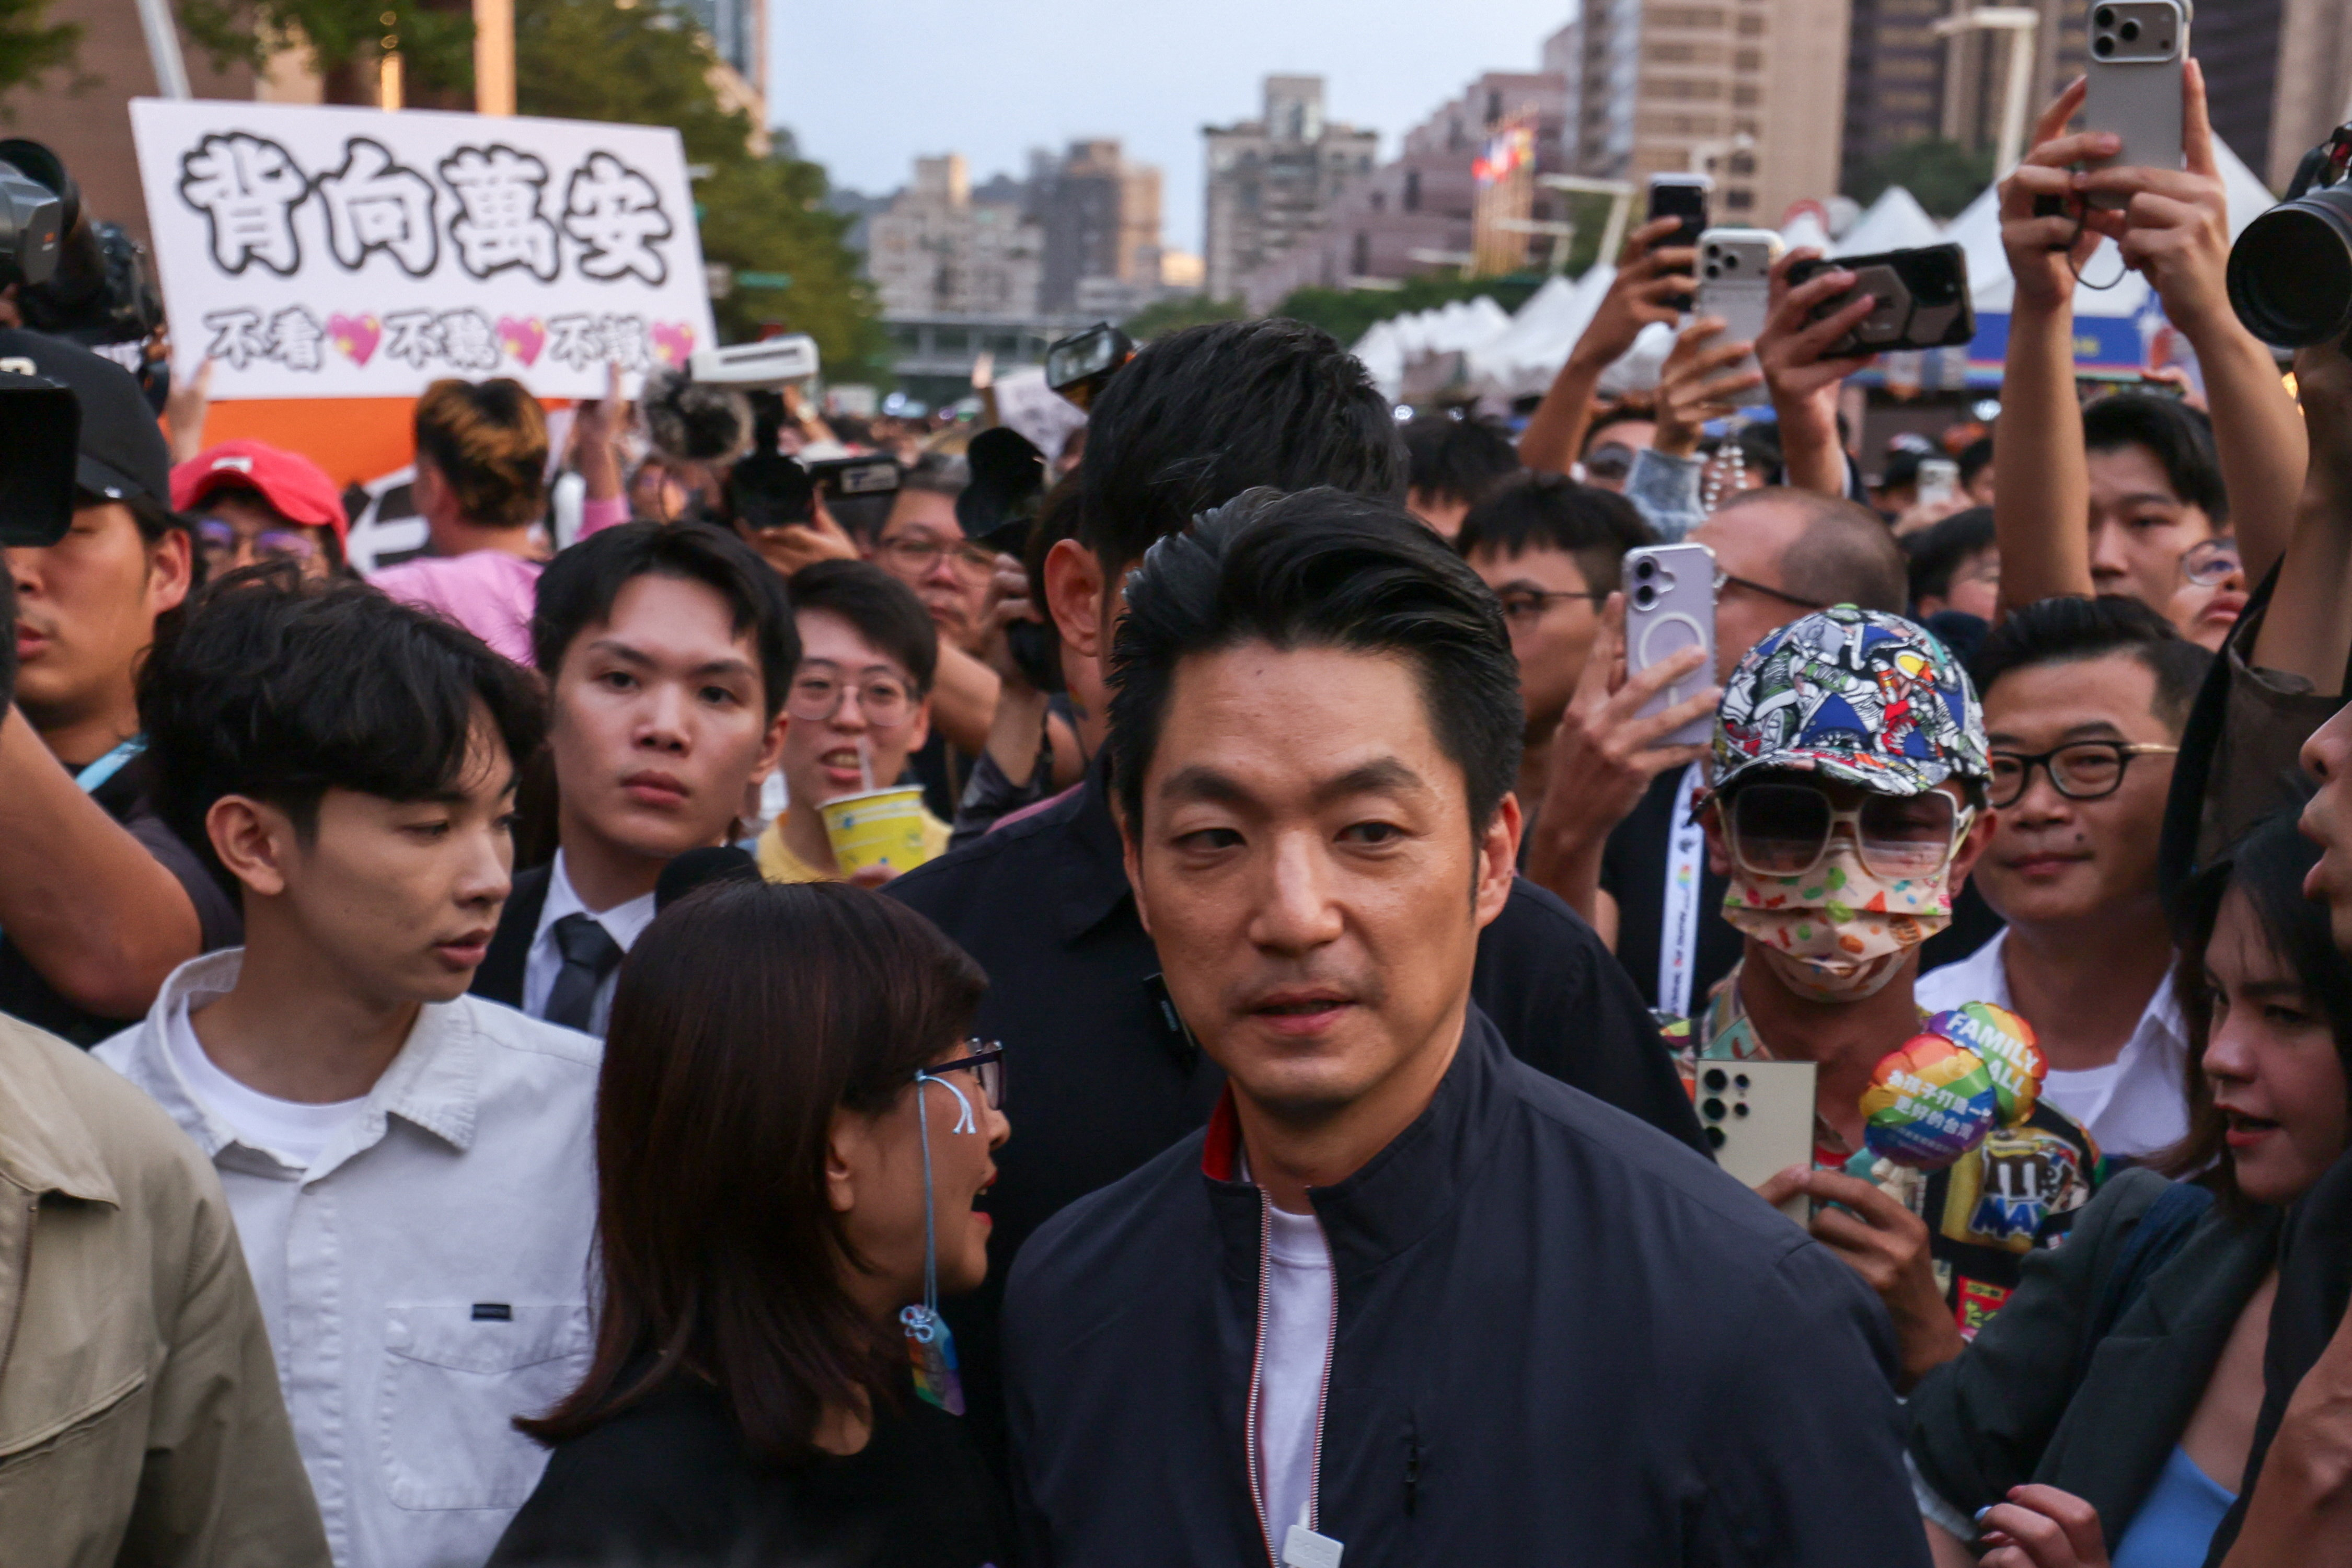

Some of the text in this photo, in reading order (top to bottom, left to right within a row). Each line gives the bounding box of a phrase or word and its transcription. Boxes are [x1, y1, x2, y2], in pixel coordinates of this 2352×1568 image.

[178, 129, 673, 287] 背向萬安
[204, 304, 324, 372] 不看
[383, 305, 501, 371] 不聽
[1945, 1012, 2040, 1073] FAMILY
[1987, 1059, 2023, 1098] ALL
